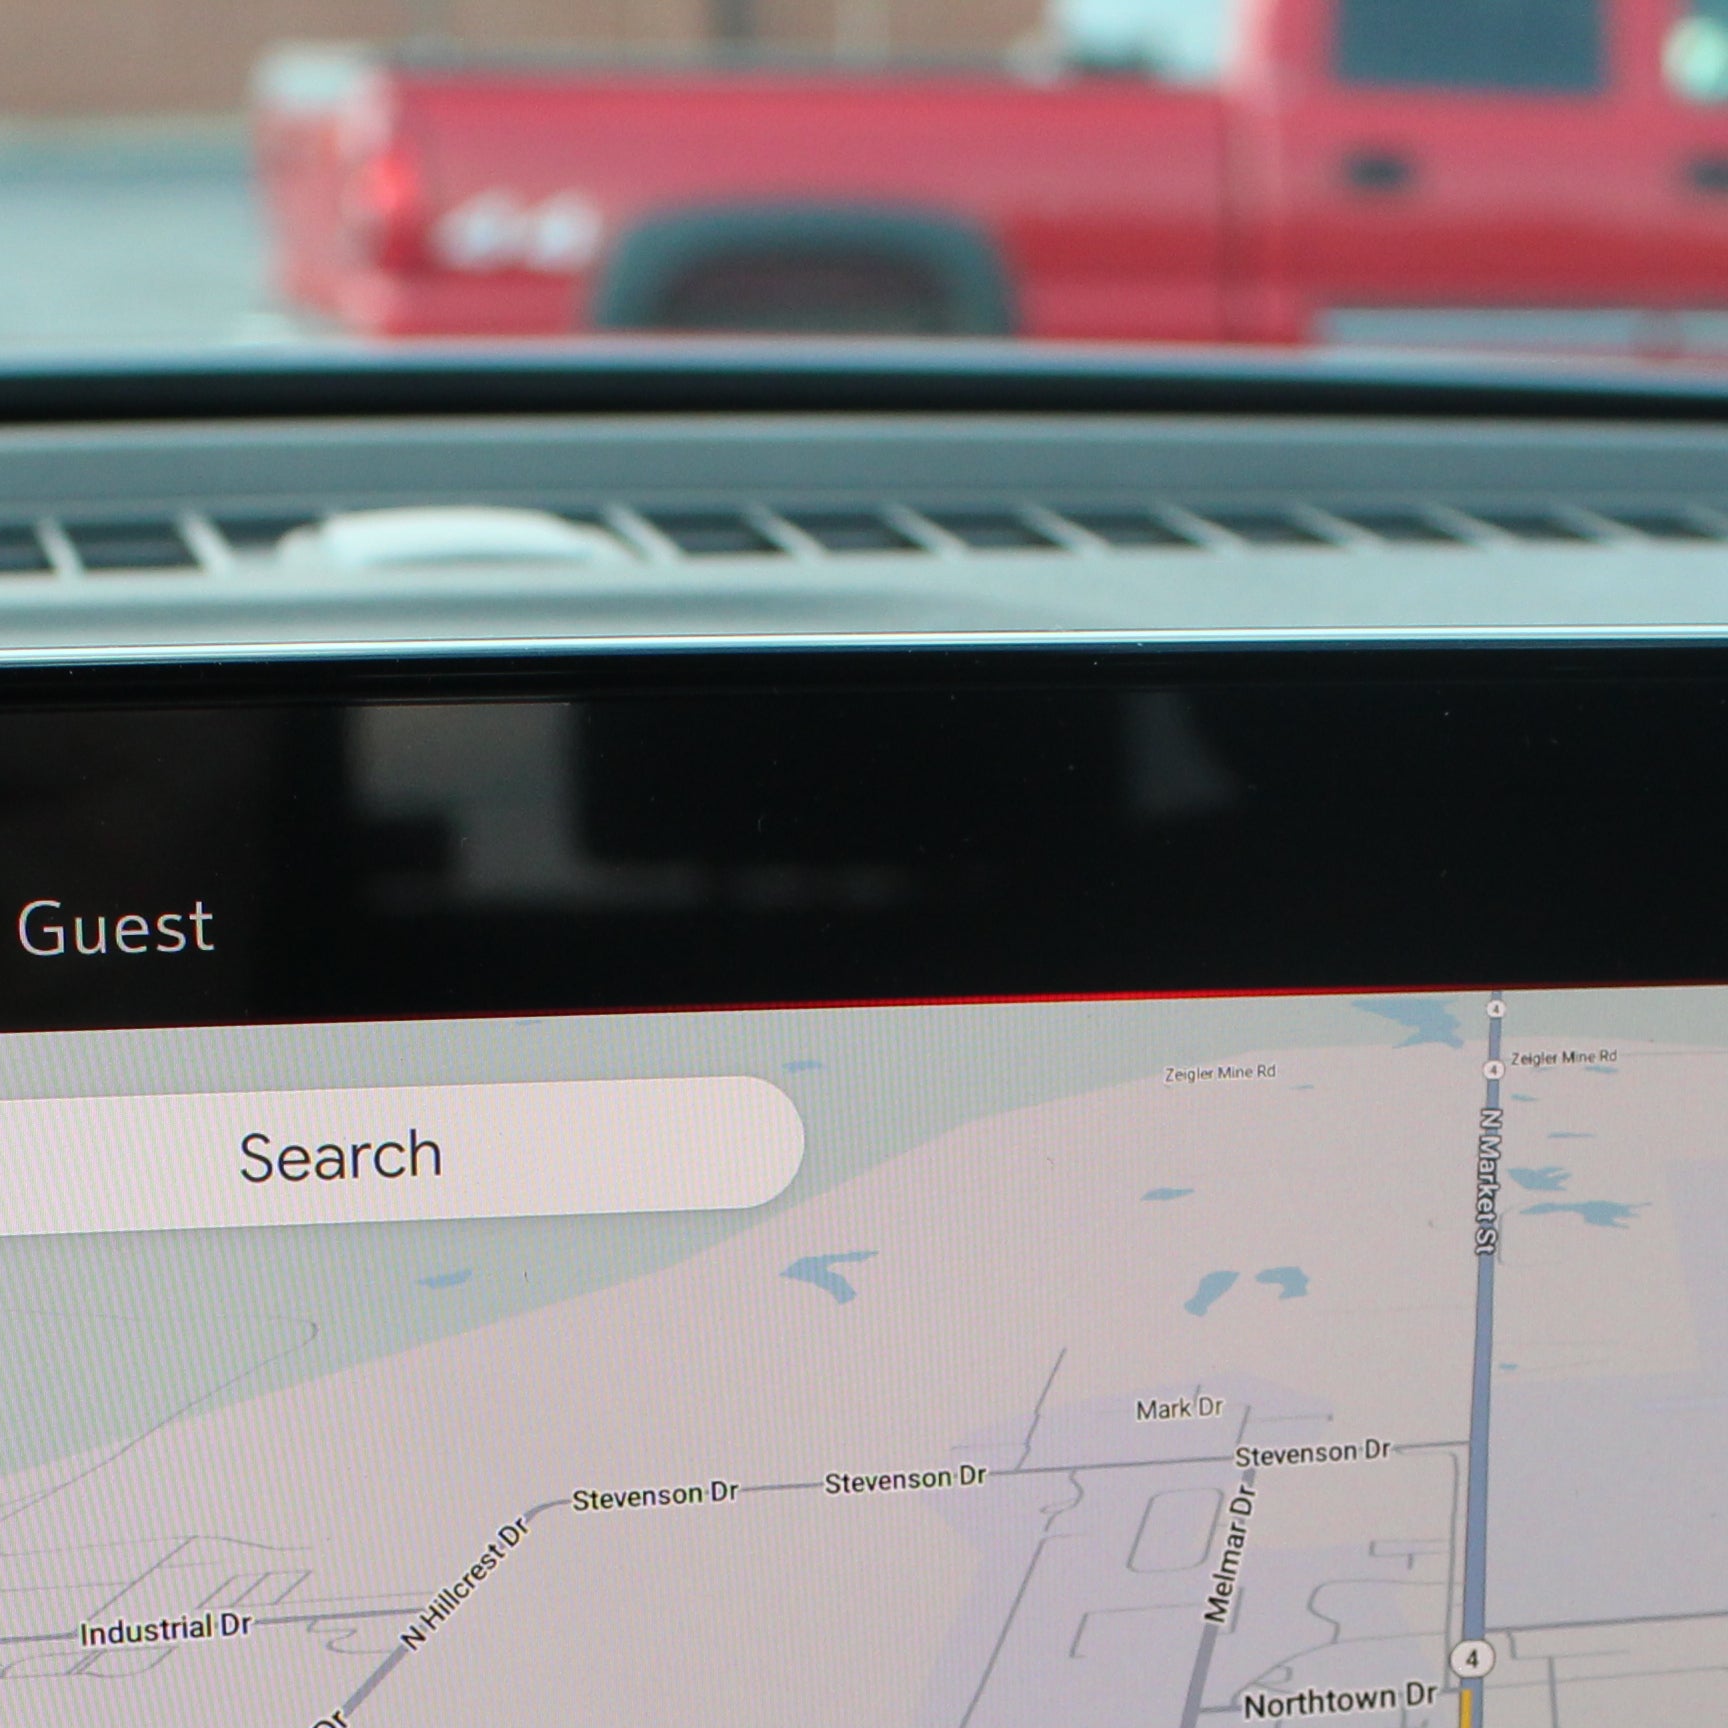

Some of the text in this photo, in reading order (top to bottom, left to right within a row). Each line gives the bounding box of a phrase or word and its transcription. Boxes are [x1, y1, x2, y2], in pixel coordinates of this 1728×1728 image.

[16, 898, 216, 957] Guest
[1164, 1062, 1277, 1083] Zeigler Mine Rd
[1510, 1049, 1618, 1068] Zeigler Mine Rd
[239, 1128, 443, 1184] Search
[1474, 1109, 1503, 1255] N Market St
[1135, 1395, 1224, 1421] Mark Dr
[1235, 1437, 1392, 1467] Stevenson Dr
[572, 1478, 740, 1511] Stevenson Dr
[824, 1463, 987, 1495] Stevenson Dr
[1204, 1485, 1257, 1624] Melmar Dr
[399, 1514, 532, 1653] N Hillcrest Dr
[79, 1611, 255, 1646] Industrial Dr
[1464, 1647, 1480, 1670] 4
[1242, 1681, 1439, 1720] Northtown Dr
